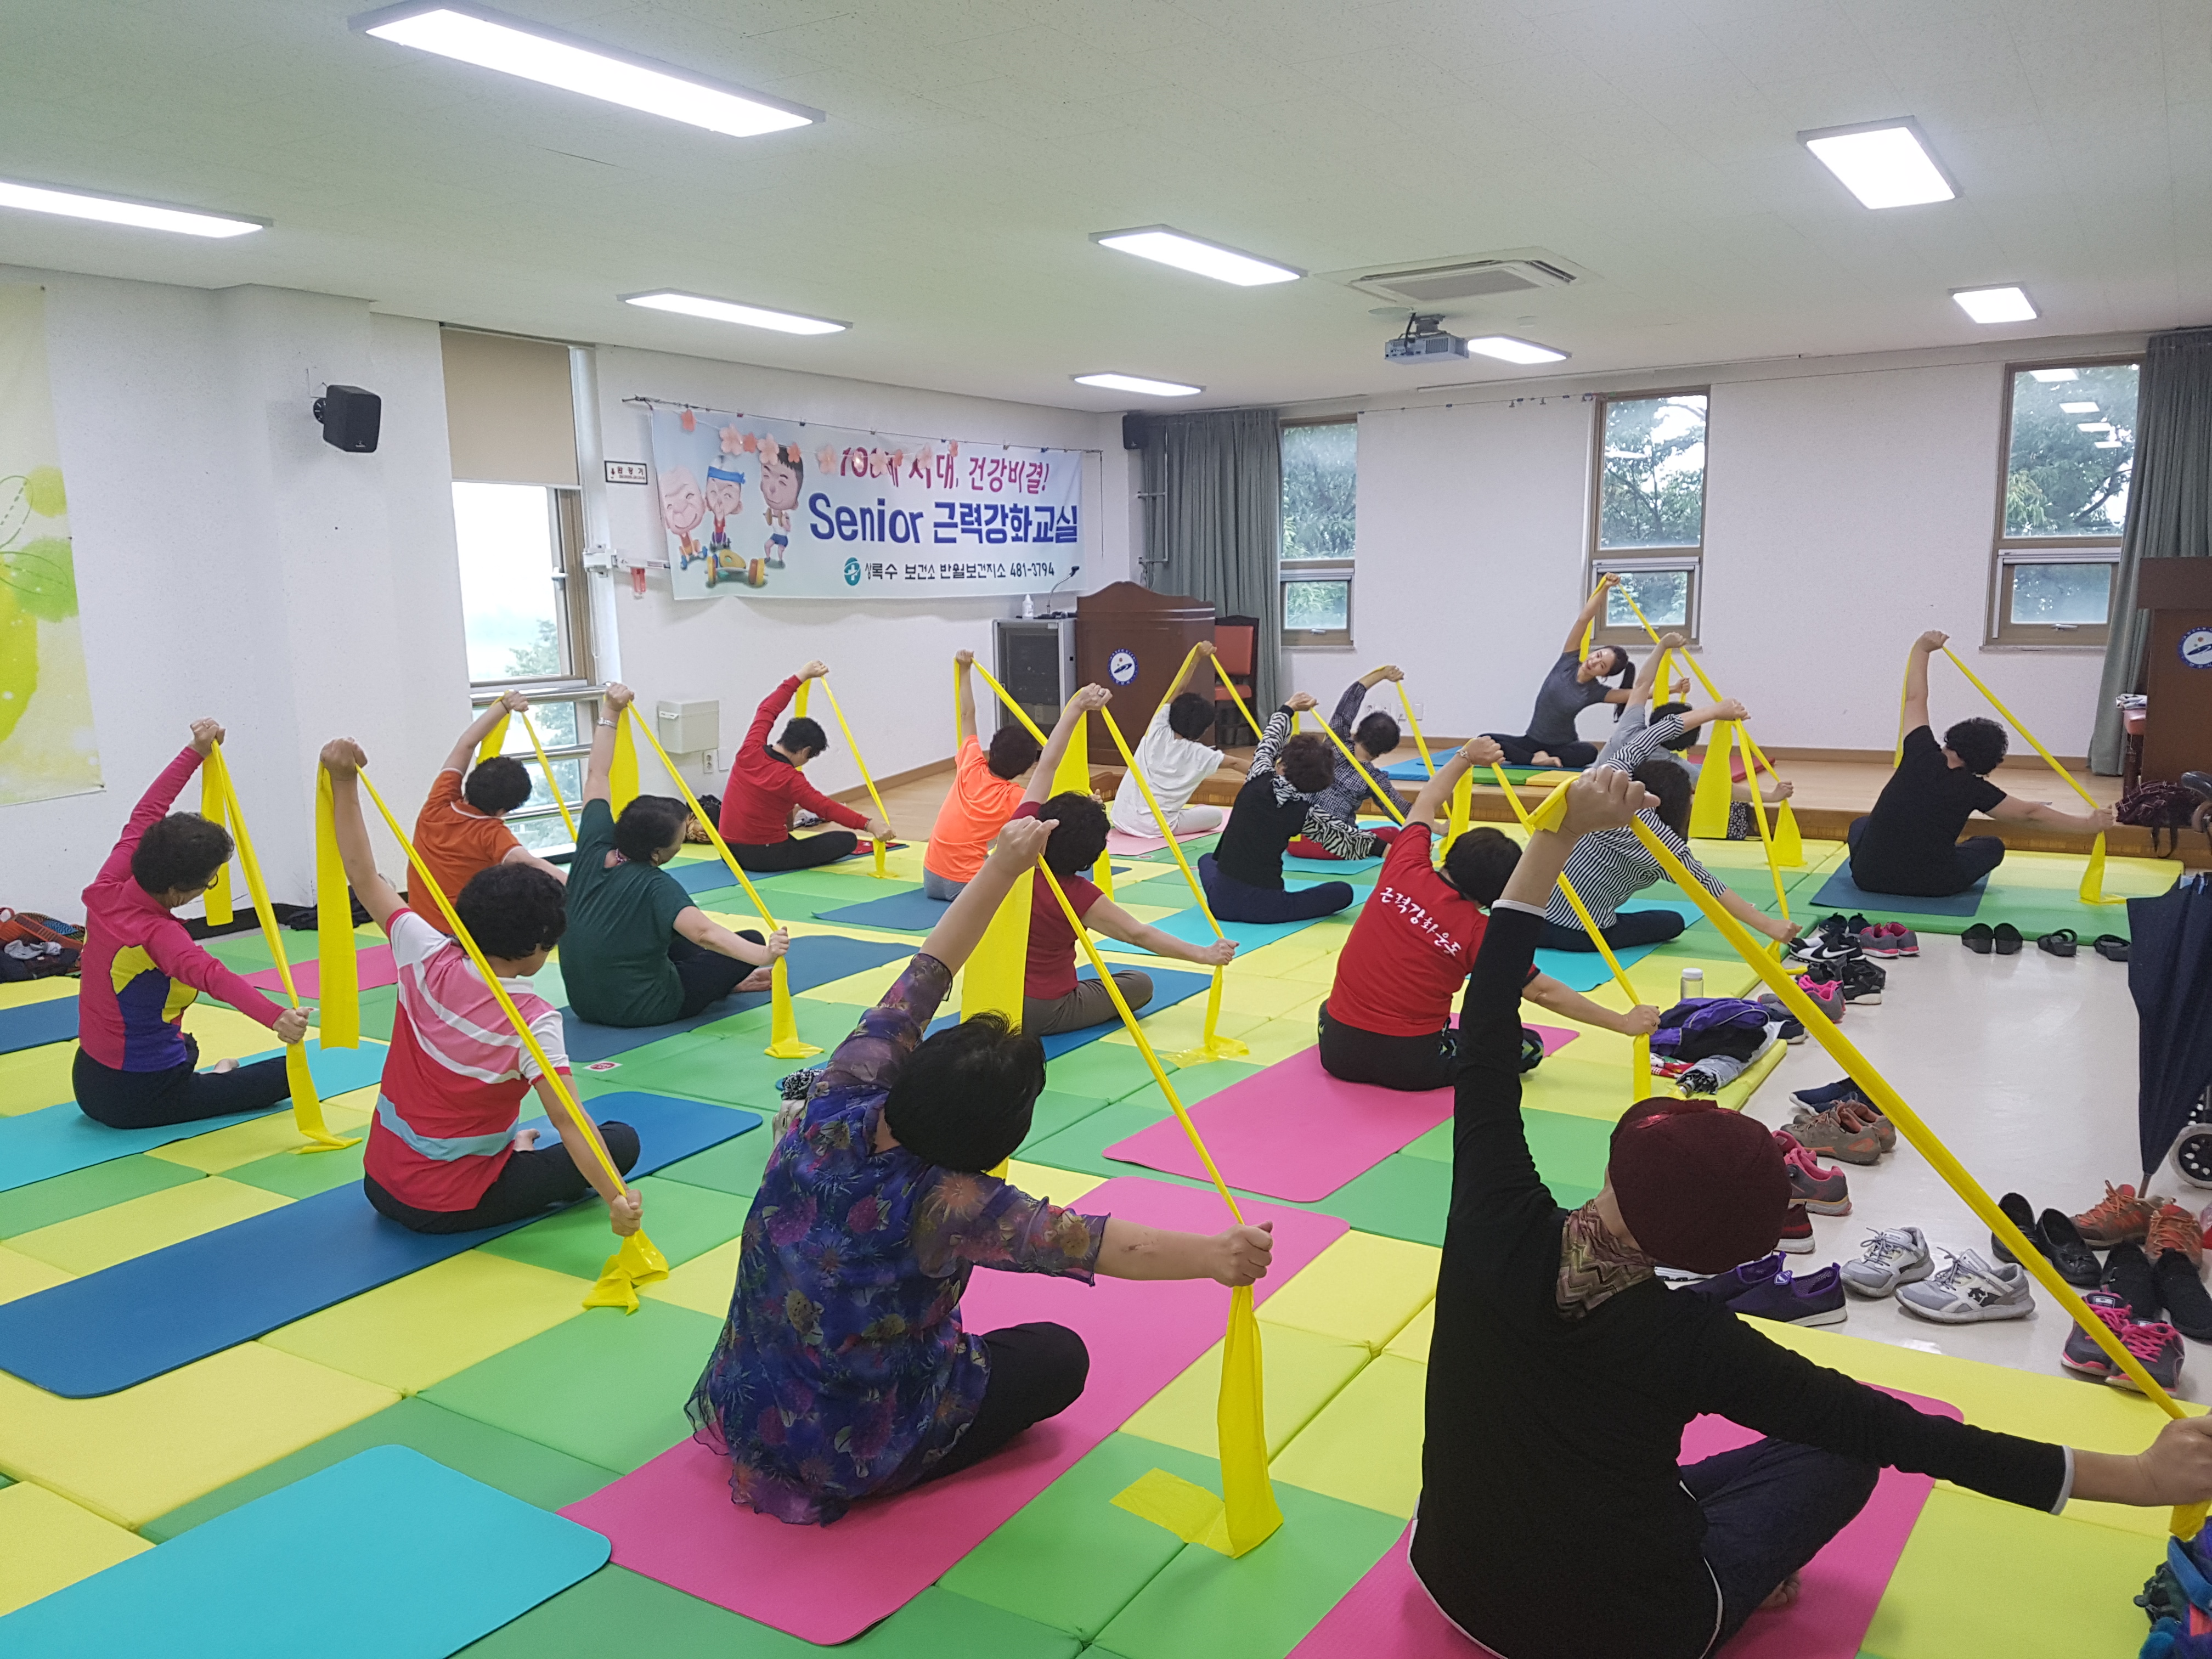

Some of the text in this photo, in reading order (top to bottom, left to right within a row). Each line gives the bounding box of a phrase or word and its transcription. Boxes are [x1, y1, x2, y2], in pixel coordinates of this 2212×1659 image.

[969, 456, 1049, 494] 건강비결!
[808, 492, 1078, 544] Senior 근력강화교실
[865, 561, 1055, 580] 상록수 보건소 반월보건지소 481-3794
